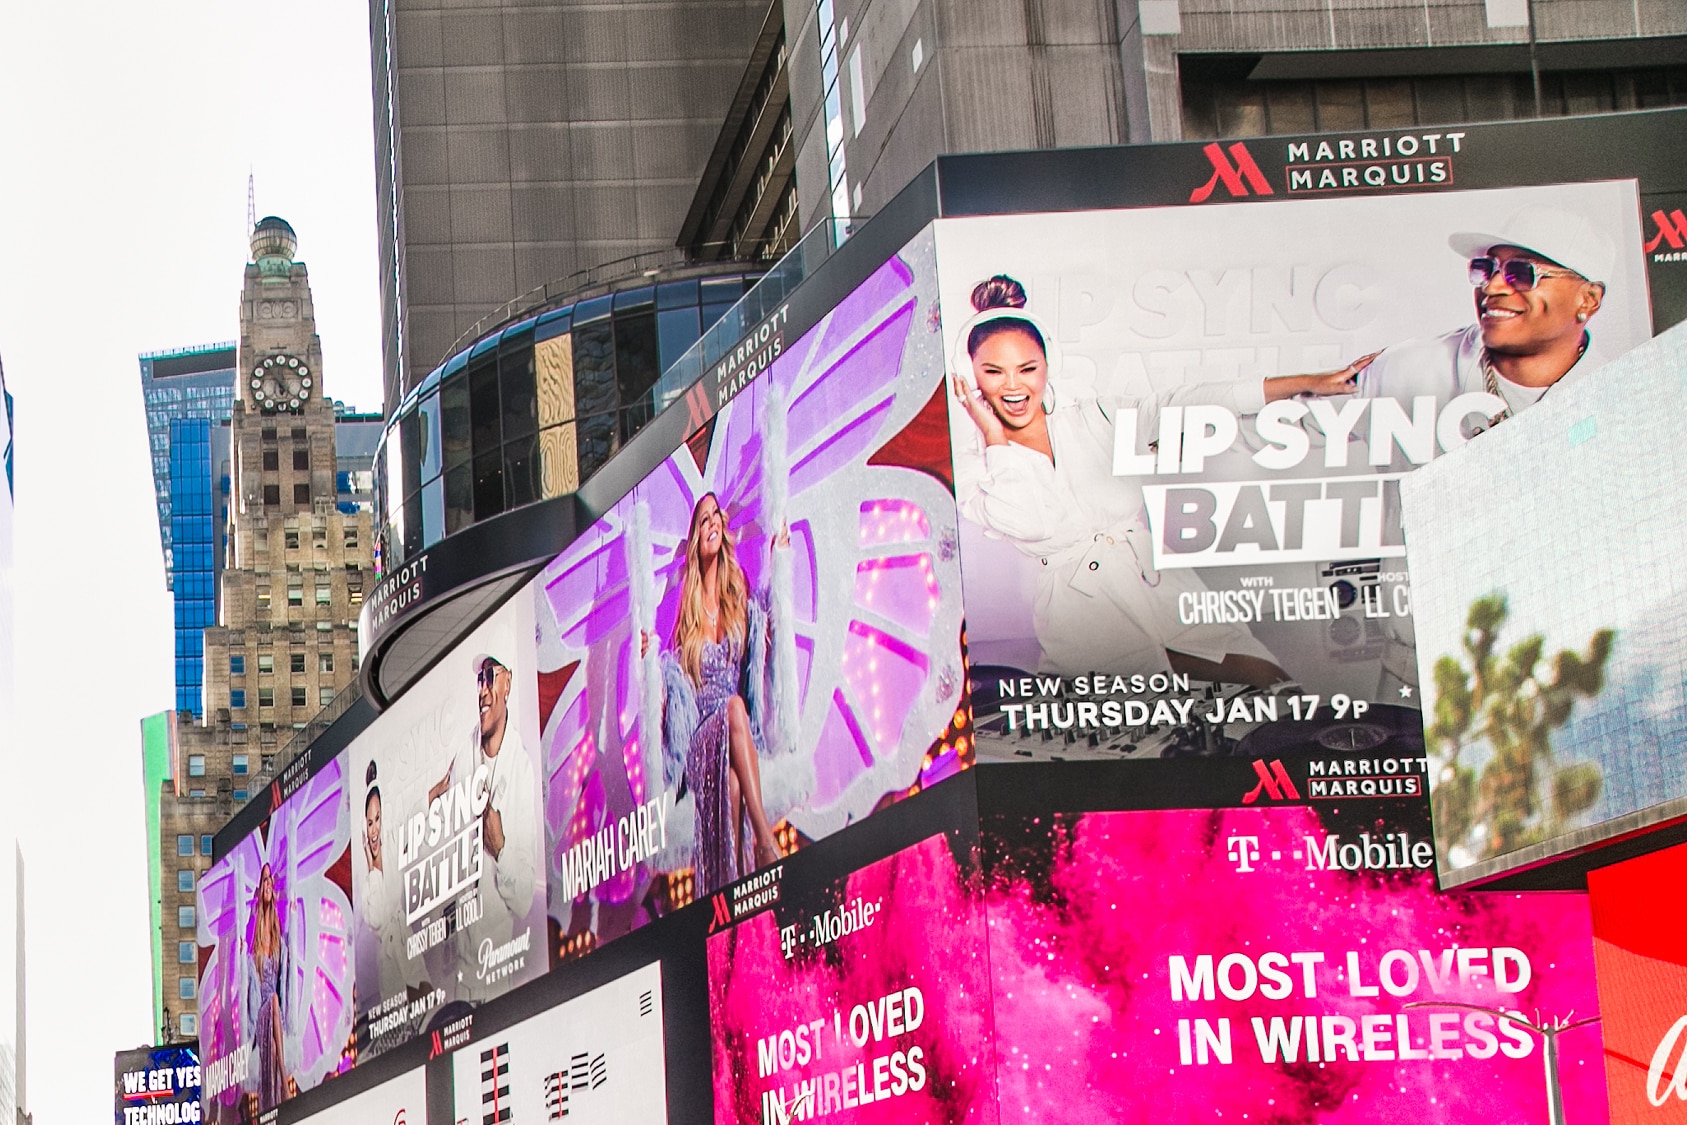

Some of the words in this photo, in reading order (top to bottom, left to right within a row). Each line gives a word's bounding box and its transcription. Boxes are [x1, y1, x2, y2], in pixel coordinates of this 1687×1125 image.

[1287, 131, 1466, 163] MARRIOTT
[1290, 160, 1449, 190] MARQUIS
[715, 303, 791, 382] MARRIOTT
[718, 338, 783, 406] MARQUIS
[1112, 404, 1238, 477] LIP
[1240, 576, 1273, 588] WITH
[1178, 590, 1264, 625] CHRISSY
[1272, 586, 1340, 622] TEIGEN
[1363, 585, 1390, 619] LL
[998, 677, 1061, 698] NEW
[1074, 673, 1191, 696] SEASON
[1000, 698, 1194, 731] THURSDAY
[1206, 696, 1279, 725] JAN
[1286, 694, 1322, 721] 17
[284, 749, 311, 784] MARRIOTT
[284, 768, 309, 799] MARQUIS
[1312, 778, 1418, 797] MARQUIS
[398, 811, 426, 871] LIP
[427, 764, 490, 847] SYNC
[560, 811, 615, 904] MARIAH
[616, 791, 669, 872] CAREY
[408, 824, 480, 914] BATTLE
[733, 865, 783, 900] MARRIOTT
[734, 885, 779, 917] MARQUIS
[407, 928, 429, 960] CHRISSY
[428, 916, 447, 949] TEIGEN
[463, 898, 478, 929] COOL
[476, 927, 531, 980] Paramount
[485, 957, 525, 985] NETWORK
[1168, 952, 1325, 1001] MOST
[1346, 947, 1532, 998] LOVED
[368, 1006, 382, 1021] NEW
[382, 990, 408, 1014] SEASON
[368, 1005, 410, 1040] THURSDAY
[409, 1000, 426, 1020] JAN
[427, 993, 435, 1011] 17
[443, 1014, 473, 1036] MARRIOTT
[443, 1029, 470, 1050] MARQUIS
[758, 1018, 825, 1079] MOST
[834, 986, 924, 1049] LOVED
[1178, 1017, 1233, 1065] IN
[1251, 1010, 1536, 1064] WIRELESS
[123, 1071, 146, 1095] WE
[149, 1069, 174, 1092] GET
[206, 1056, 229, 1100] MARIAH
[229, 1044, 250, 1087] CAREY
[794, 1046, 927, 1122] WIRELESS
